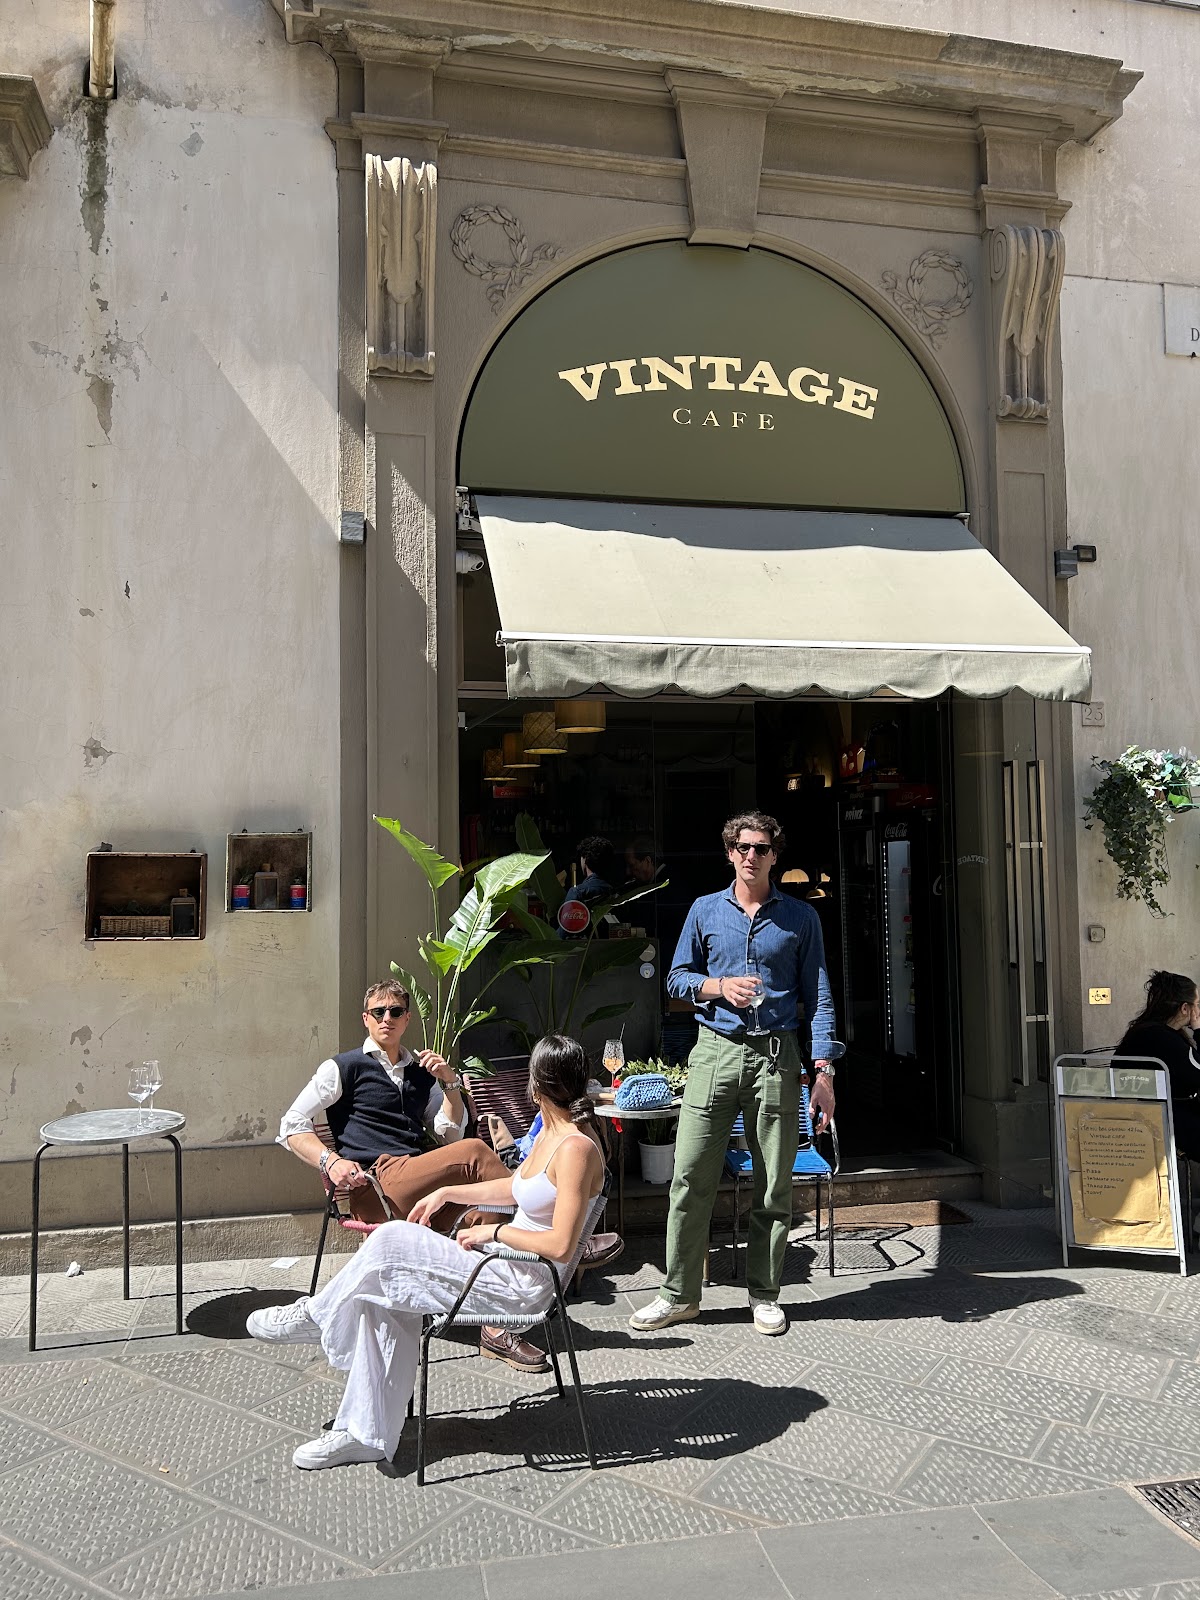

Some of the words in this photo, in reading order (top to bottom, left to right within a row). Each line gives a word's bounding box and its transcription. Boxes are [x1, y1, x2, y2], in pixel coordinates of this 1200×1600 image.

[557, 355, 879, 420] VINTAGE
[672, 408, 775, 431] CAFE
[1084, 707, 1103, 721] 25
